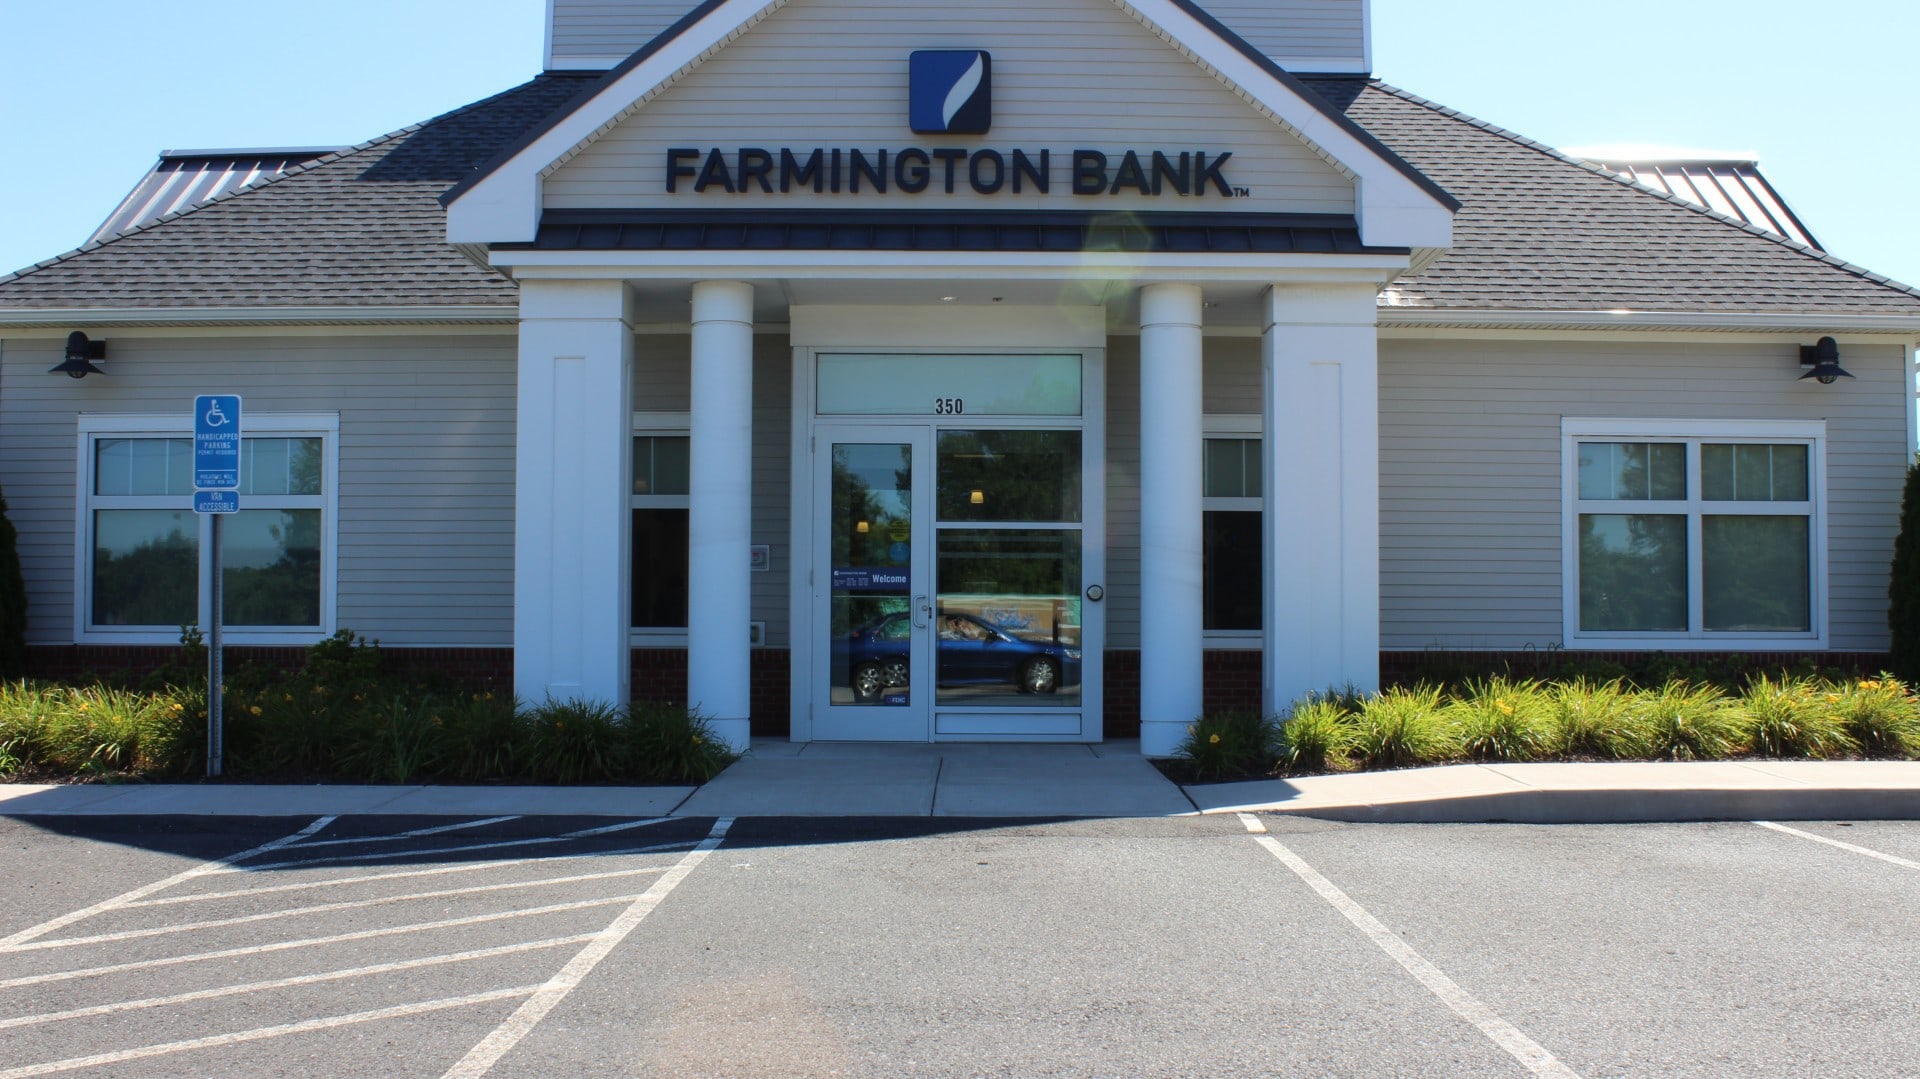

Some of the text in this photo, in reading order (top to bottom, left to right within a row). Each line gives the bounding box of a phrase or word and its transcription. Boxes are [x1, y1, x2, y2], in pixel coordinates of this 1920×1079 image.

[664, 147, 1050, 195] FARMINGTON
[1072, 148, 1233, 197] BANK
[935, 398, 963, 414] 350
[211, 492, 223, 501] VAN
[198, 502, 235, 512] ACCESSIBLE
[872, 574, 907, 583] Welcome
